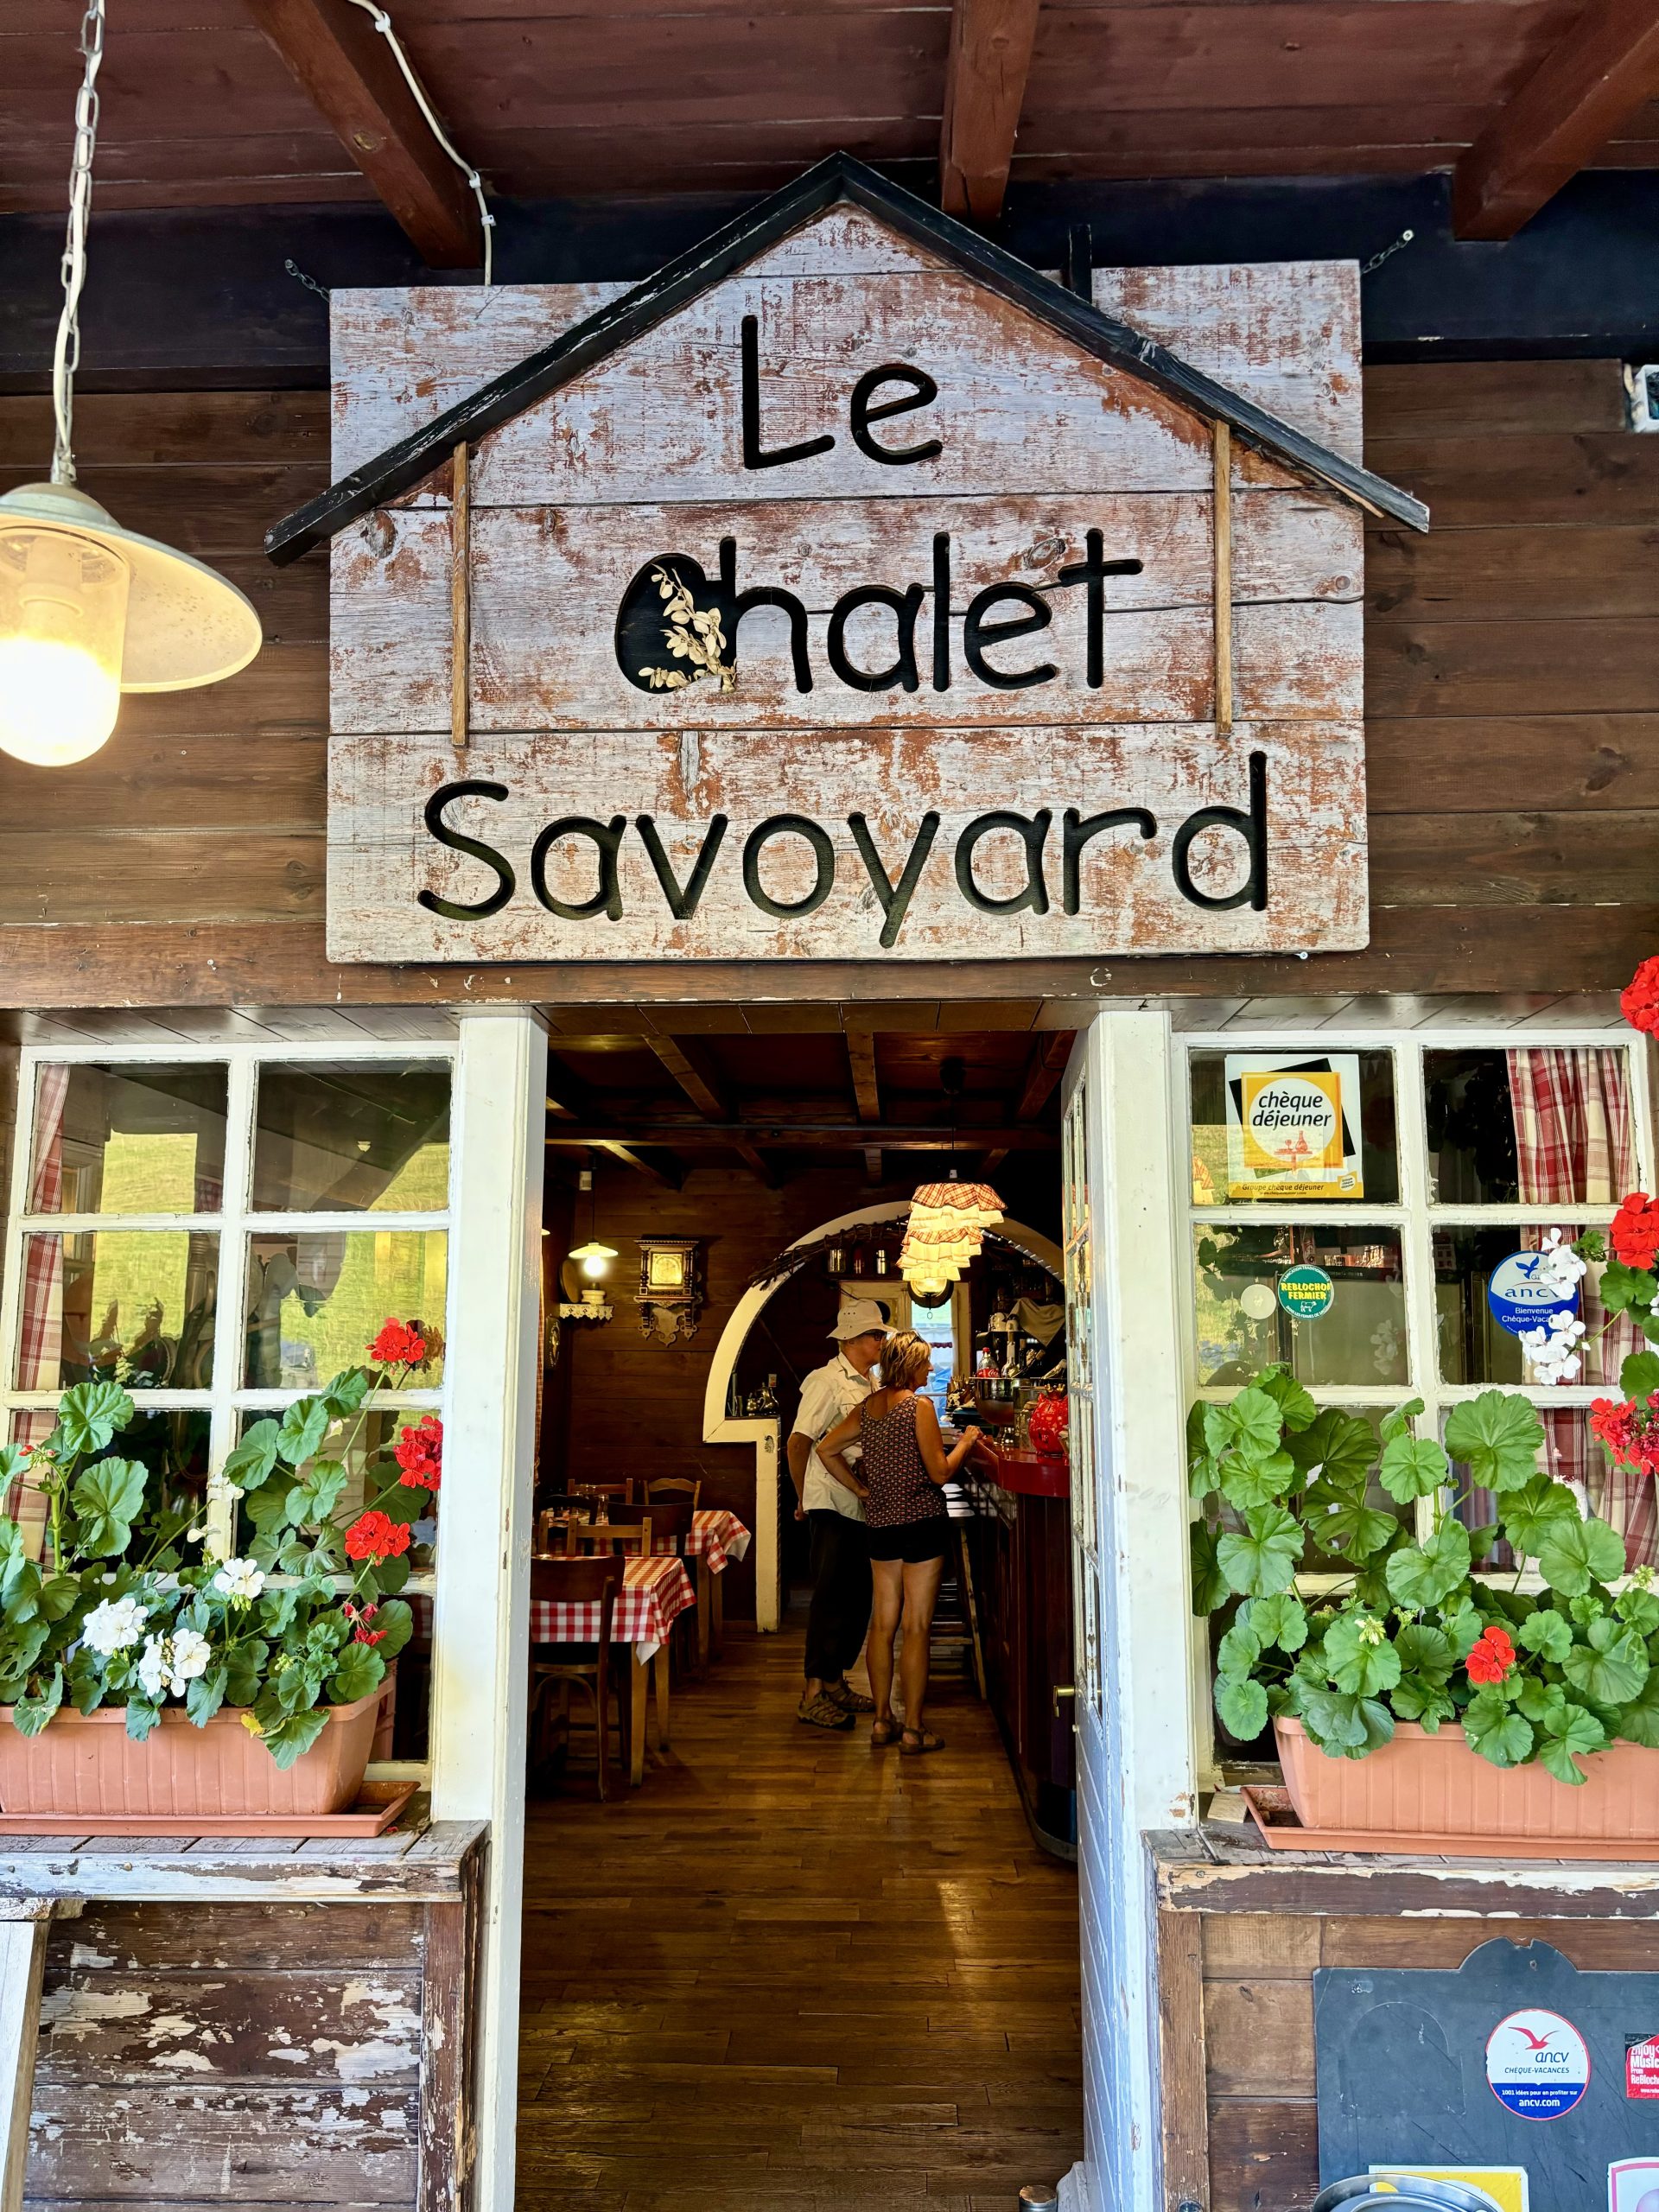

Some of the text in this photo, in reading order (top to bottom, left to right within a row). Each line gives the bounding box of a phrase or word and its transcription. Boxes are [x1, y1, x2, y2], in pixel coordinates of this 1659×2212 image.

[741, 314, 944, 471] Le
[613, 528, 1144, 695] Chalet
[417, 750, 1268, 950] Savoyard
[1258, 1090, 1324, 1113] chèque
[1252, 1109, 1332, 1131] déjeuner
[1268, 1183, 1293, 1192] chèque
[1294, 1183, 1325, 1192] déjeuner
[1287, 1291, 1327, 1300] FERMIER
[1502, 1315, 1550, 1324] Chèque-Vaca
[1535, 2051, 1570, 2063] ancv
[1630, 2055, 1659, 2069] Music
